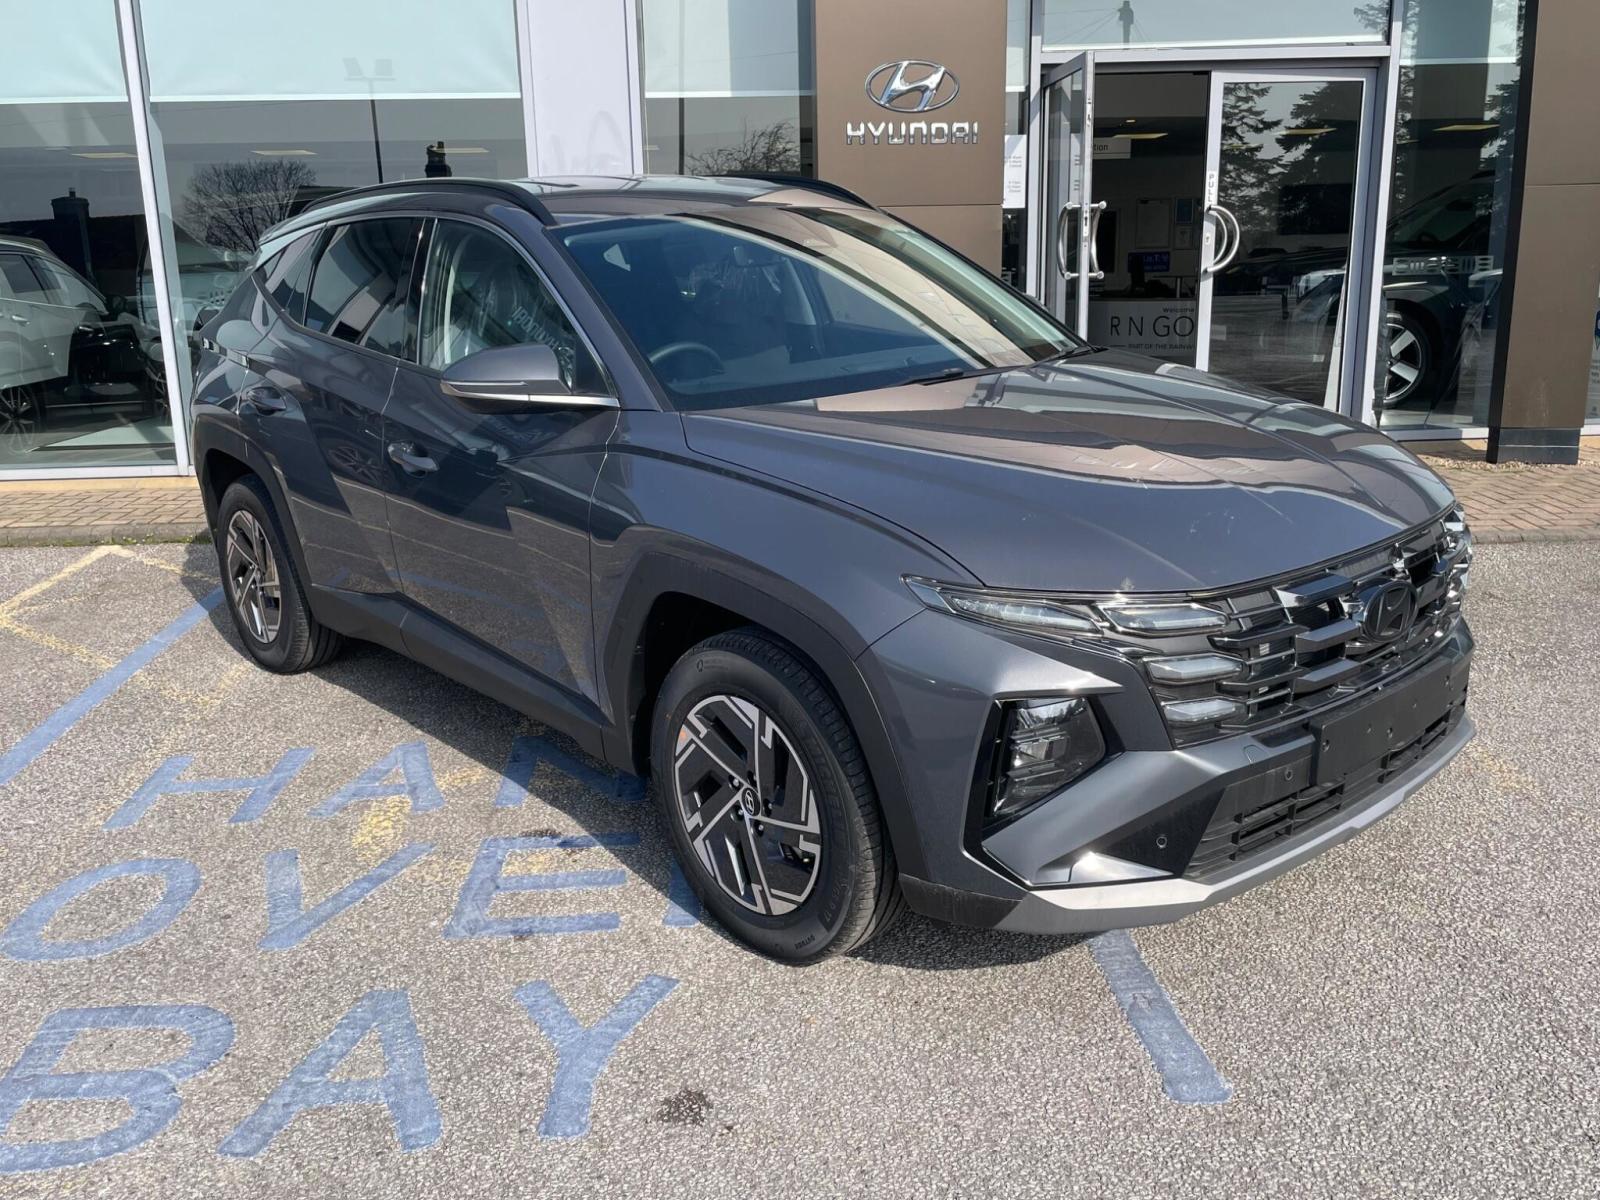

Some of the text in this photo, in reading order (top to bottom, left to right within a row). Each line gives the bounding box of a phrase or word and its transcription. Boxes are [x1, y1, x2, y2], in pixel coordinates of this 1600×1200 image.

[846, 121, 979, 145] HYUNDAI
[1110, 315, 1194, 337] R N GO
[0, 975, 680, 1173] BAY
